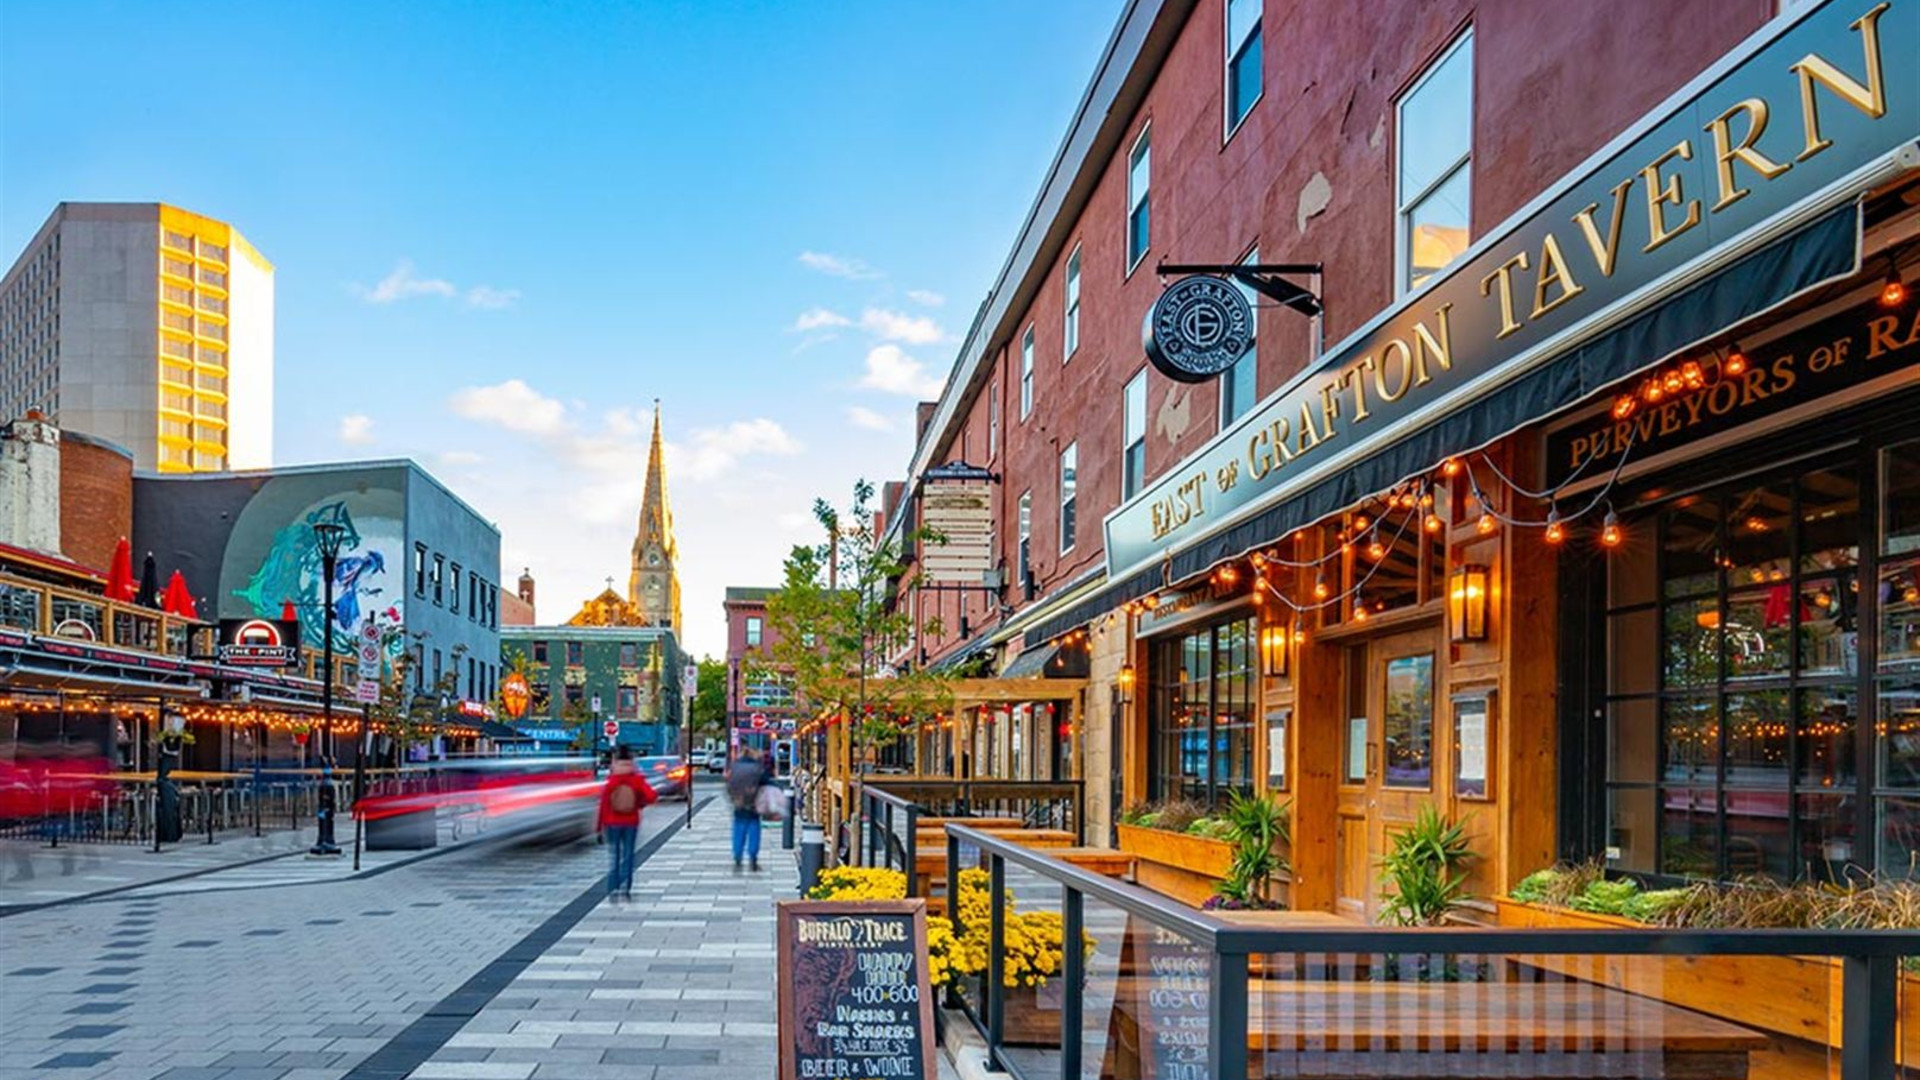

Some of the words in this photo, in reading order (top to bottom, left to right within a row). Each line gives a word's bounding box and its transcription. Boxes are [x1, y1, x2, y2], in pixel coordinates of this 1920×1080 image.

[1151, 470, 1206, 541] EAST
[1216, 457, 1239, 494] OF
[1248, 302, 1453, 481] GRAFTON
[1480, 2, 1891, 340] TAVERN
[1162, 294, 1181, 333] EAST
[1189, 283, 1243, 332] GRAFTON
[1570, 353, 1797, 468] PURVEYORS
[1808, 336, 1852, 373] OF
[798, 918, 852, 942] BUFFALO
[863, 918, 908, 942] TRACE
[858, 952, 913, 971] HAPPY
[802, 1059, 850, 1077] BEER
[852, 1062, 860, 1073] &
[864, 1057, 915, 1076] WINE
